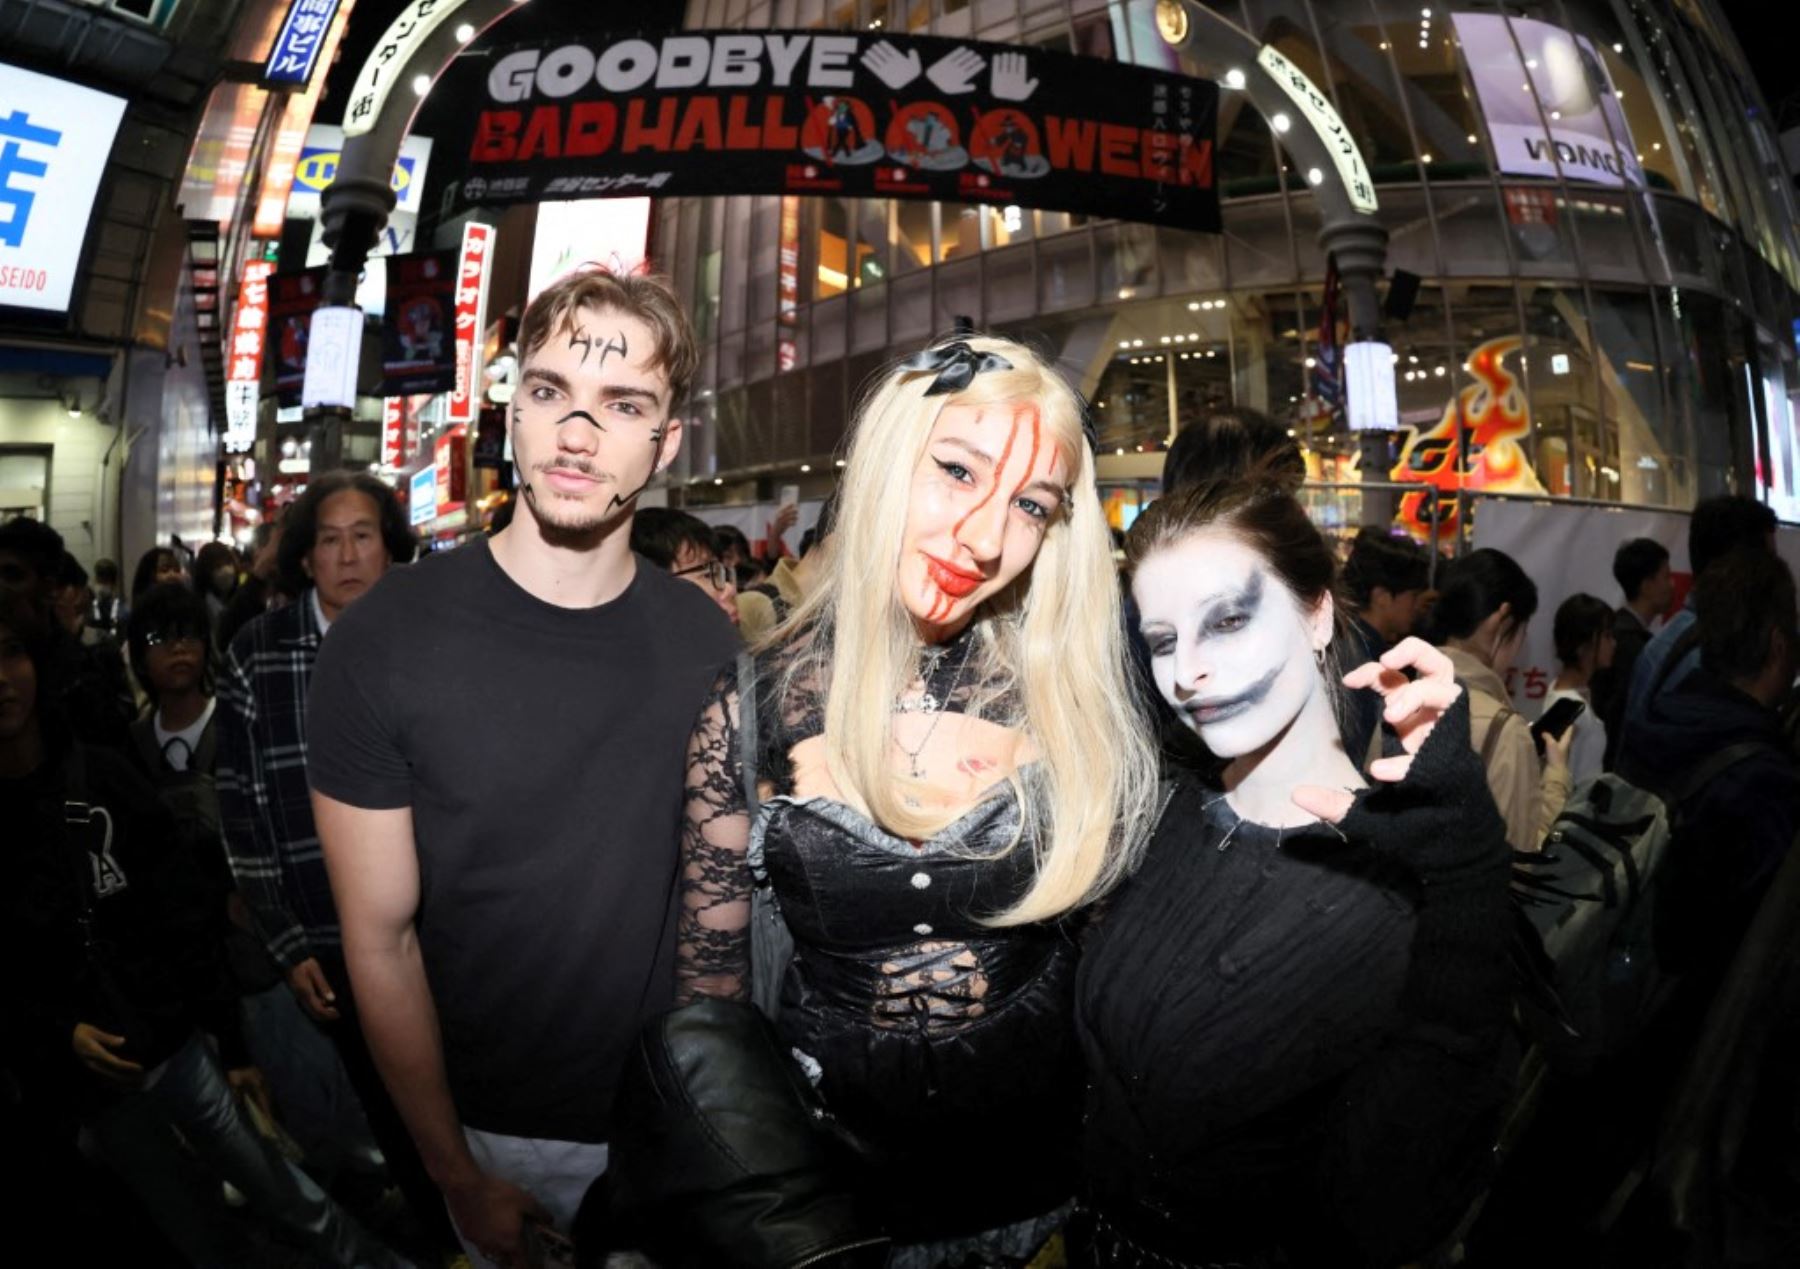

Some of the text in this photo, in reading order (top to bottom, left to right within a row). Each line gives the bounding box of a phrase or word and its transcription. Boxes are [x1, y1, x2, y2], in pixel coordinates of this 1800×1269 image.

[487, 35, 859, 104] GOODBYE
[469, 107, 618, 163] BAD
[0, 109, 63, 248] 店
[0, 266, 47, 292] SEIDO
[456, 236, 485, 330] カラオケ
